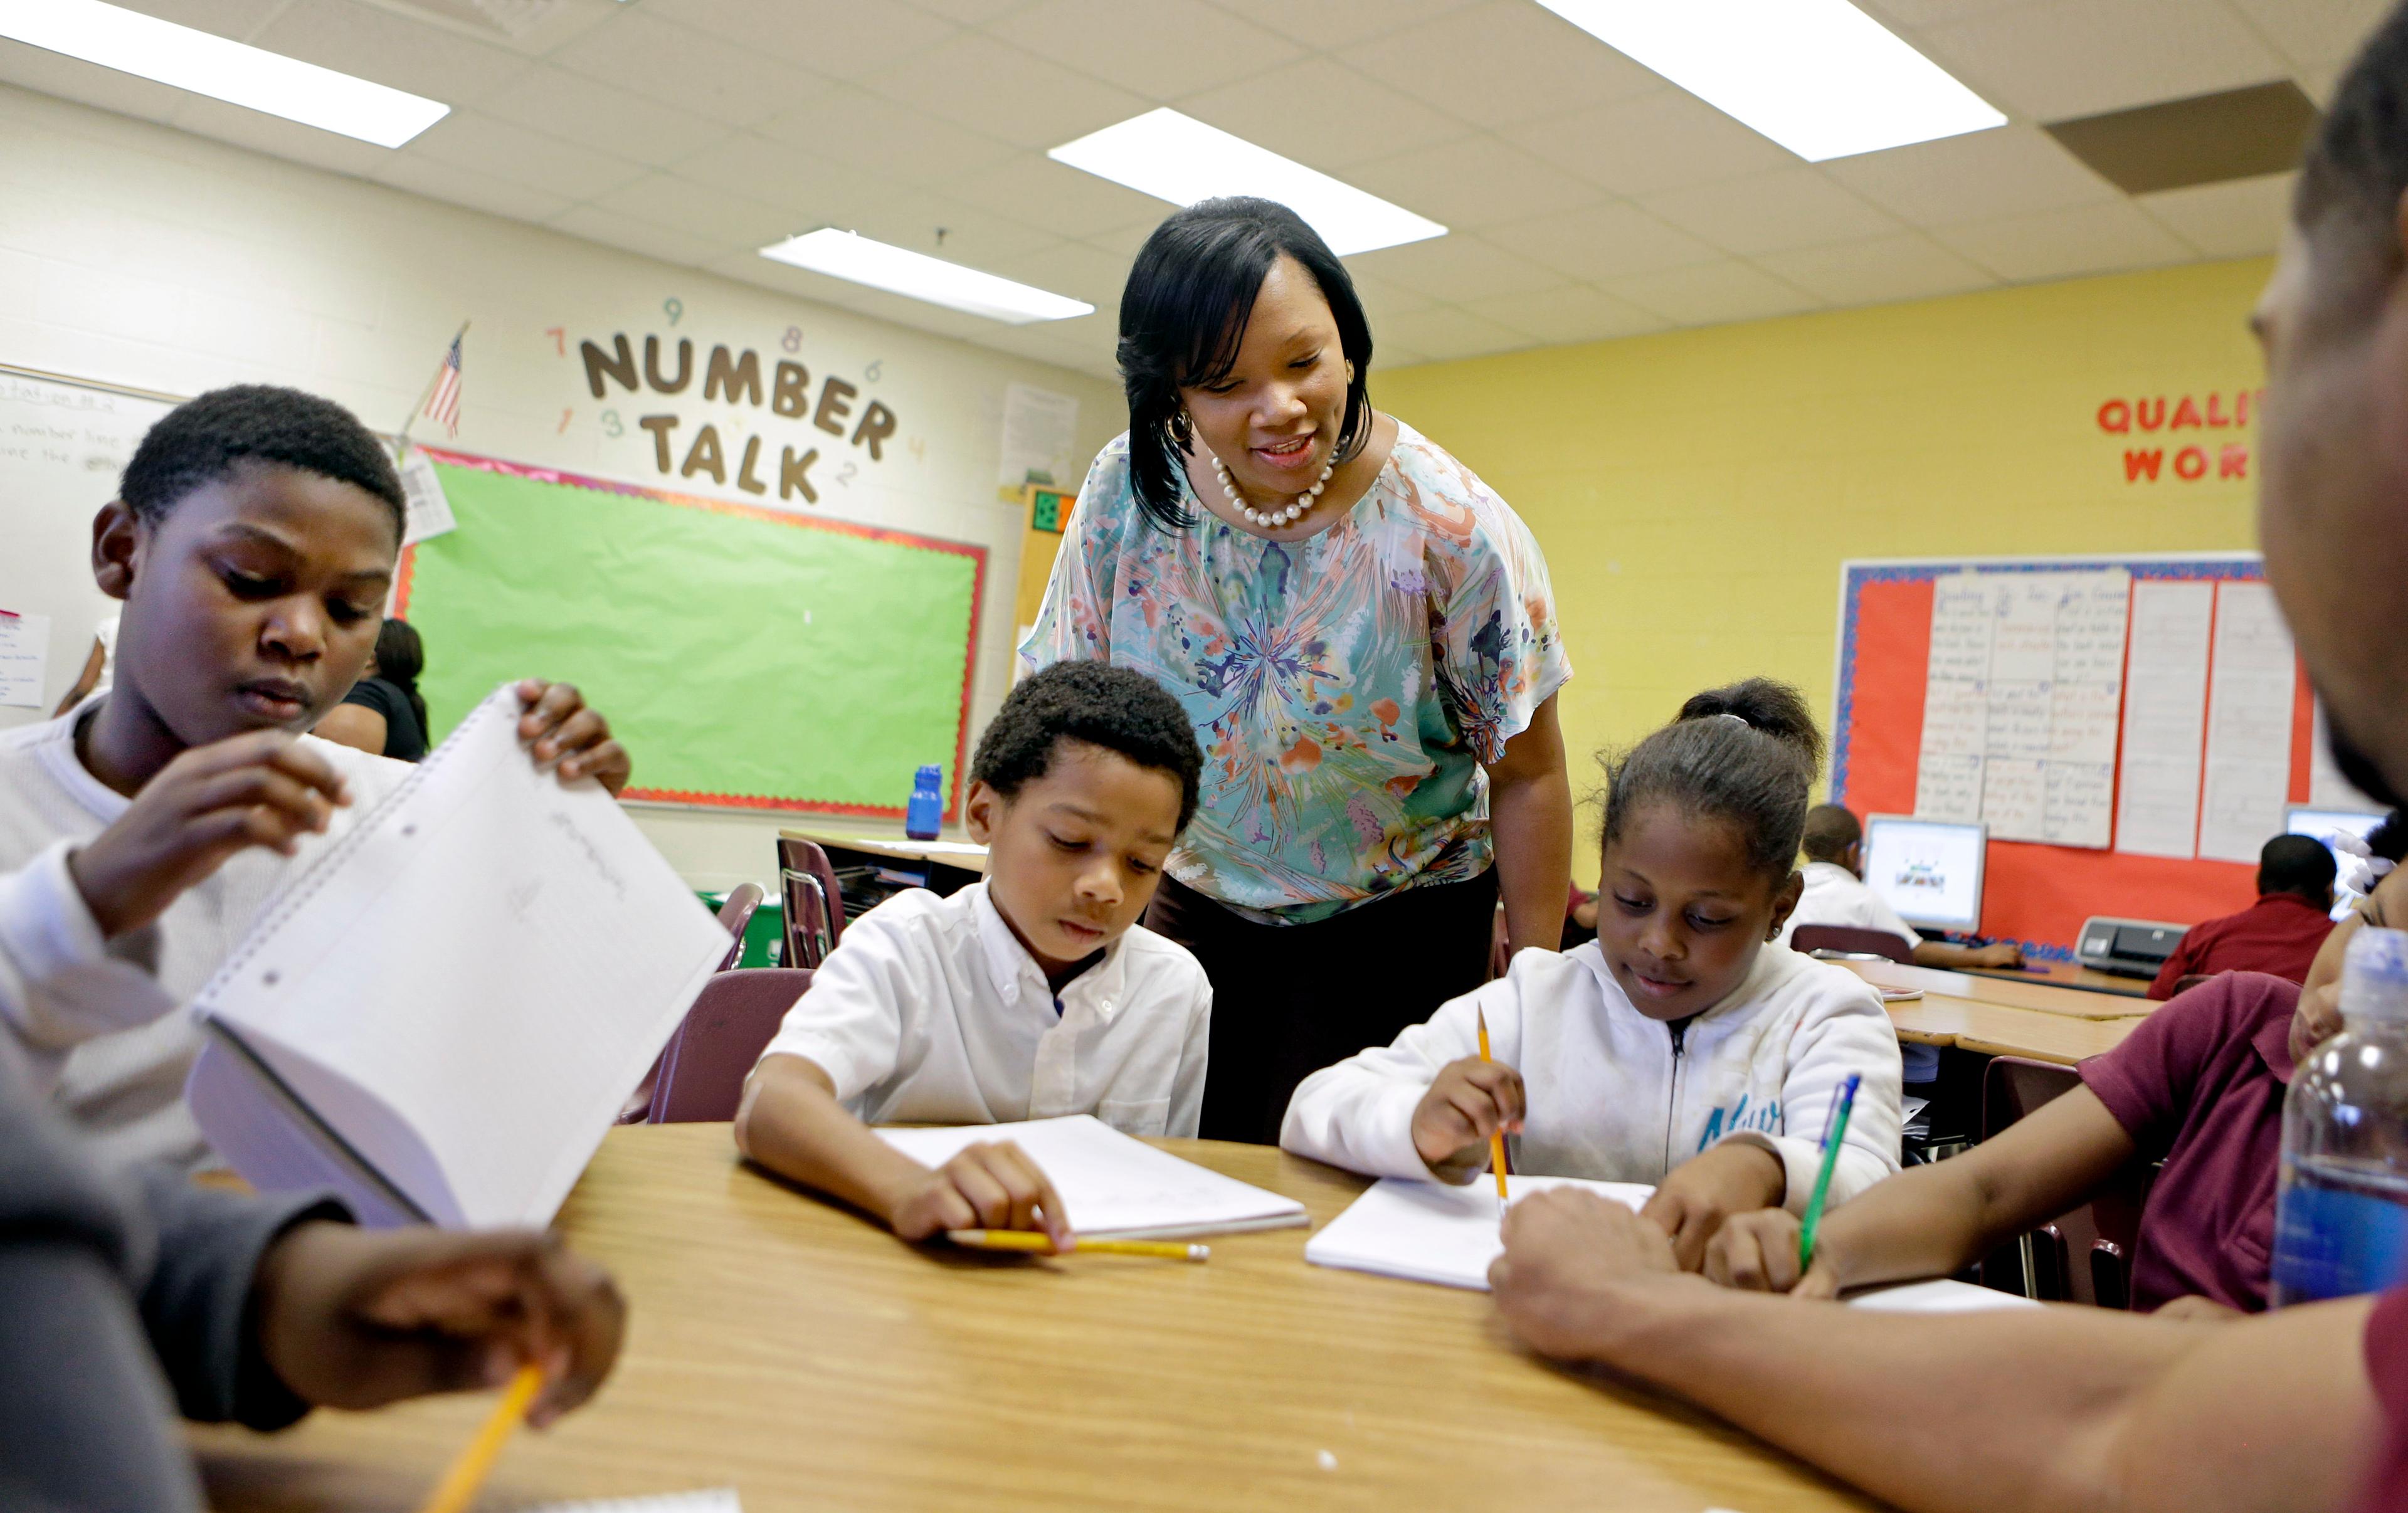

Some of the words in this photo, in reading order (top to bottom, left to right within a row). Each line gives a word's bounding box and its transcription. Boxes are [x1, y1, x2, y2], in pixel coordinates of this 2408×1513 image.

[663, 297, 683, 326] 9
[547, 328, 566, 357] 7
[781, 326, 803, 353] 8
[865, 359, 884, 383] 6
[580, 332, 897, 462] NUMBER
[601, 410, 625, 438] 3
[2098, 390, 2267, 435] QUALI
[640, 413, 820, 505] TALK
[835, 461, 858, 487] 2
